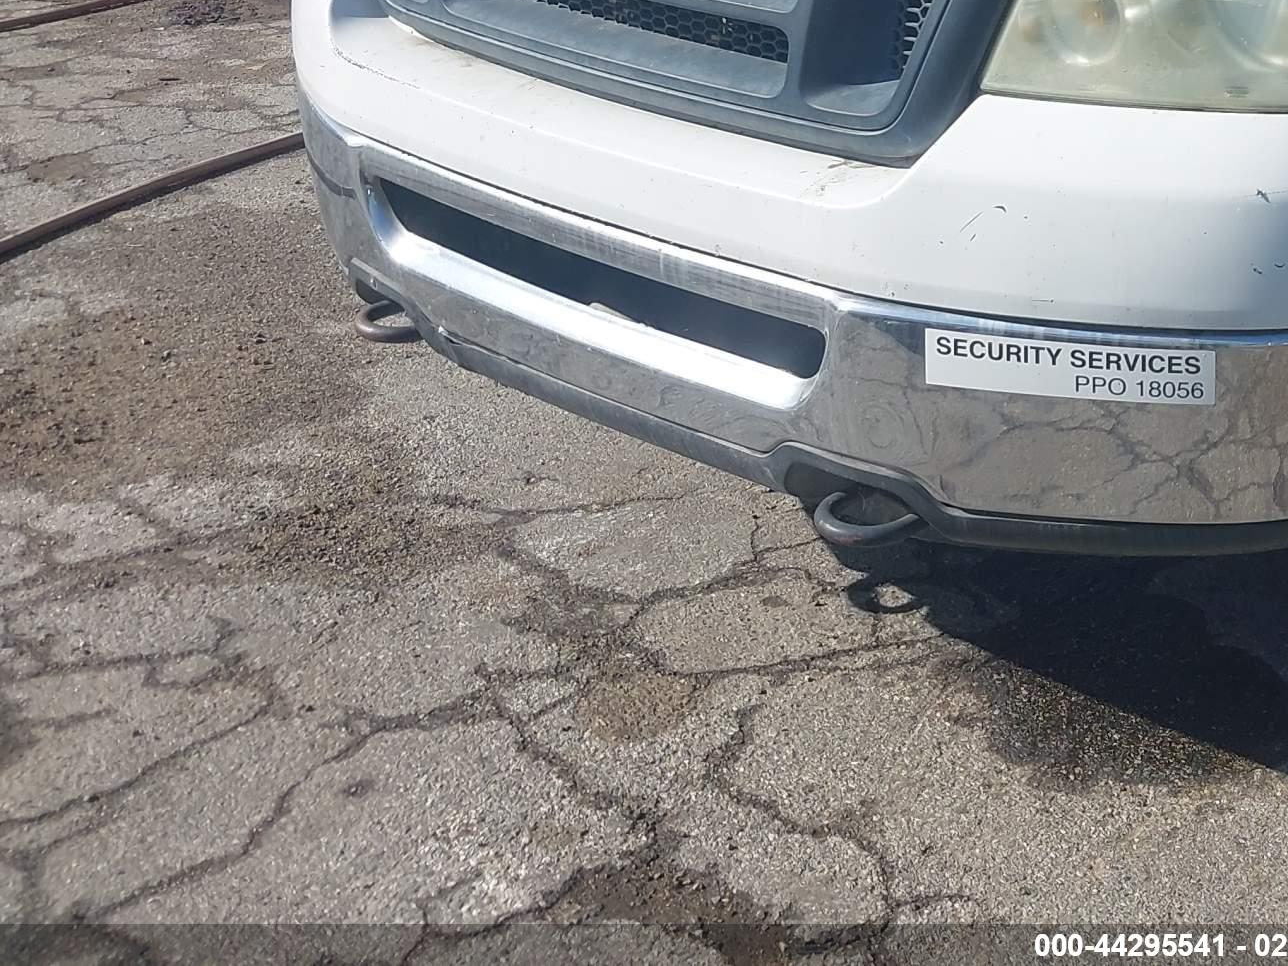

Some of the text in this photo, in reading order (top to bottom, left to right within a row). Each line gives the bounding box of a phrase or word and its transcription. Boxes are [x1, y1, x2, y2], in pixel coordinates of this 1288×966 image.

[936, 336, 1202, 374] SECURITY SERVICES
[1075, 375, 1204, 400] PPO 18056
